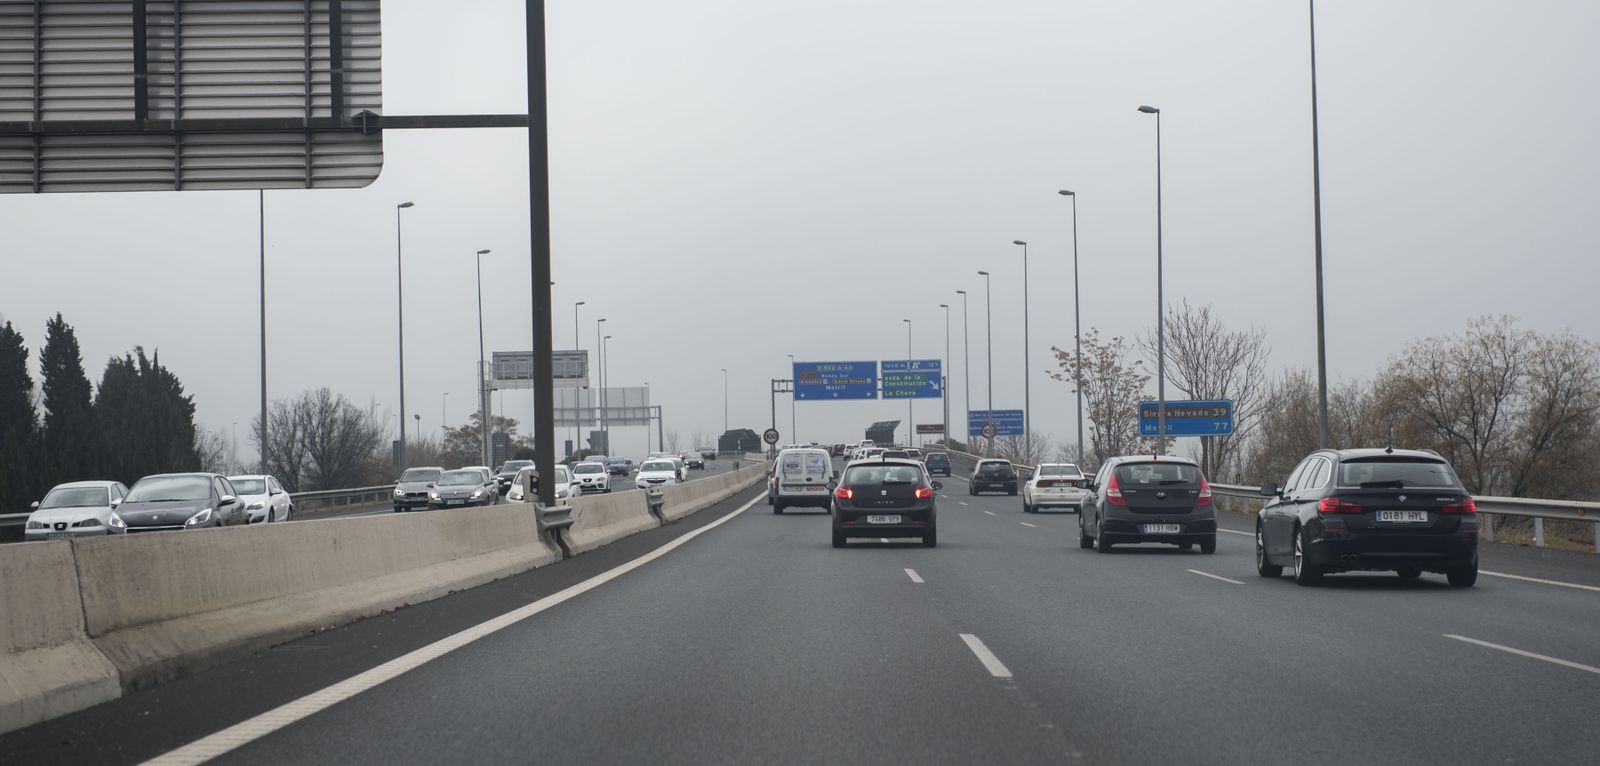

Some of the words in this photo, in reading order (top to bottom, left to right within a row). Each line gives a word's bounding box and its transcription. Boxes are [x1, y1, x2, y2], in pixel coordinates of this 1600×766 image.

[1174, 408, 1209, 416] Nevada
[1382, 511, 1404, 520] 0181
[1408, 511, 1424, 520] HYL
